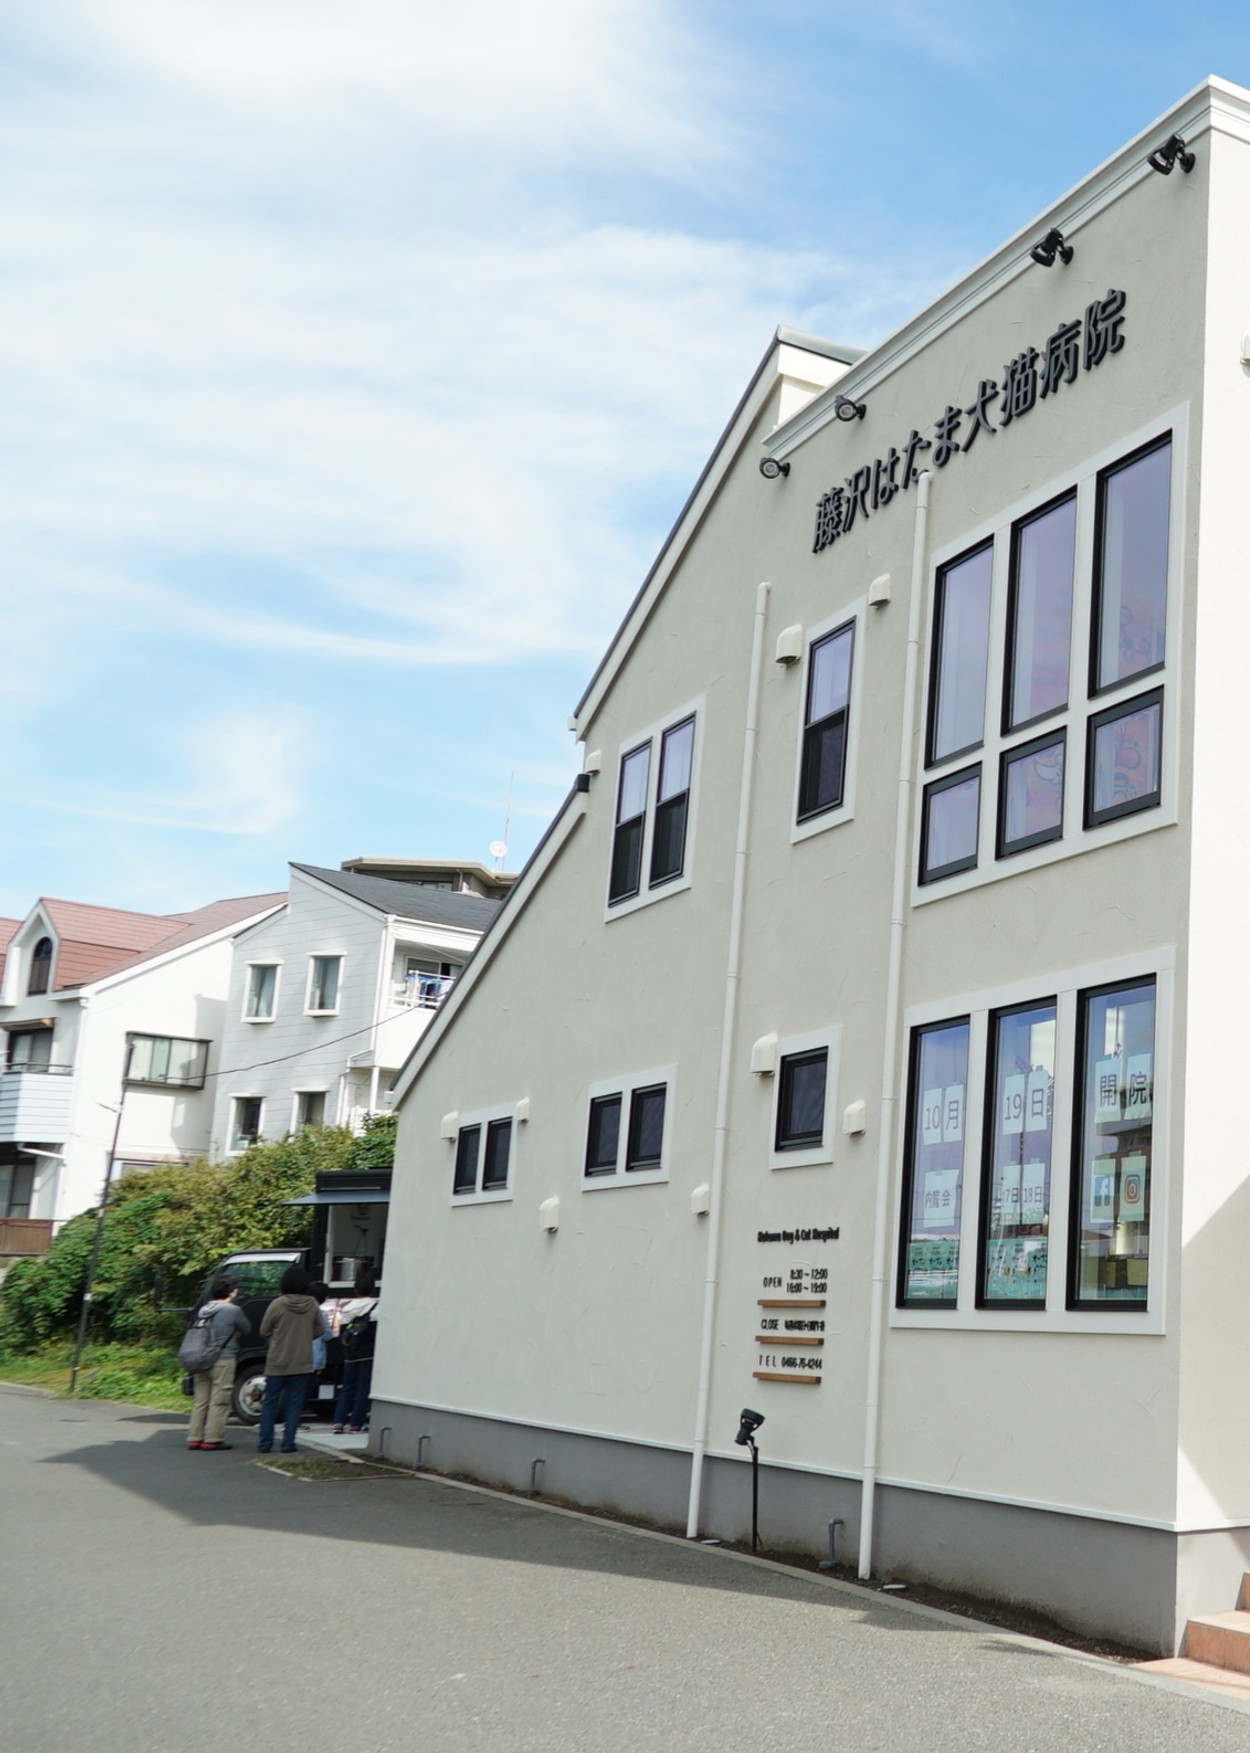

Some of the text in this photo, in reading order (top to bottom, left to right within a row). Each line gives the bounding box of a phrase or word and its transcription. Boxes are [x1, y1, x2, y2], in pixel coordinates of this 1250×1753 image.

[812, 288, 1127, 553] 藤沢はたま犬猫病院
[924, 1072, 1147, 1131] 10月 19日 開院
[763, 1277, 782, 1288] OPEN
[761, 1319, 779, 1330] CLOSE
[759, 1355, 776, 1367] TEL
